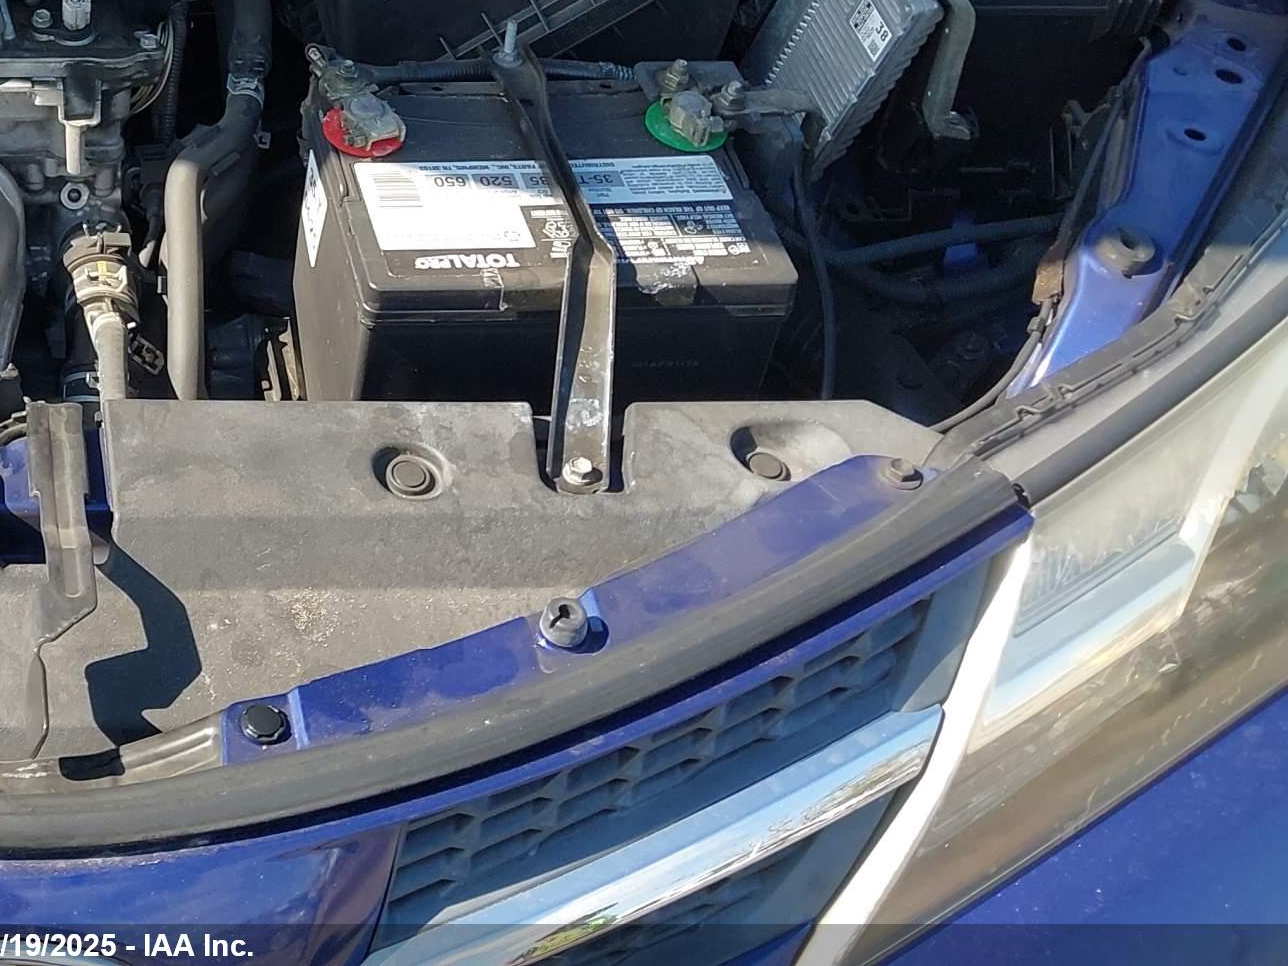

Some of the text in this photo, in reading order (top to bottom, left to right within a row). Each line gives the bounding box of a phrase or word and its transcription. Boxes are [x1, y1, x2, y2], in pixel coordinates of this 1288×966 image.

[433, 176, 467, 188] 650
[479, 175, 512, 187] 520
[579, 174, 614, 185] 35-T
[414, 253, 521, 270] TOTALPRO
